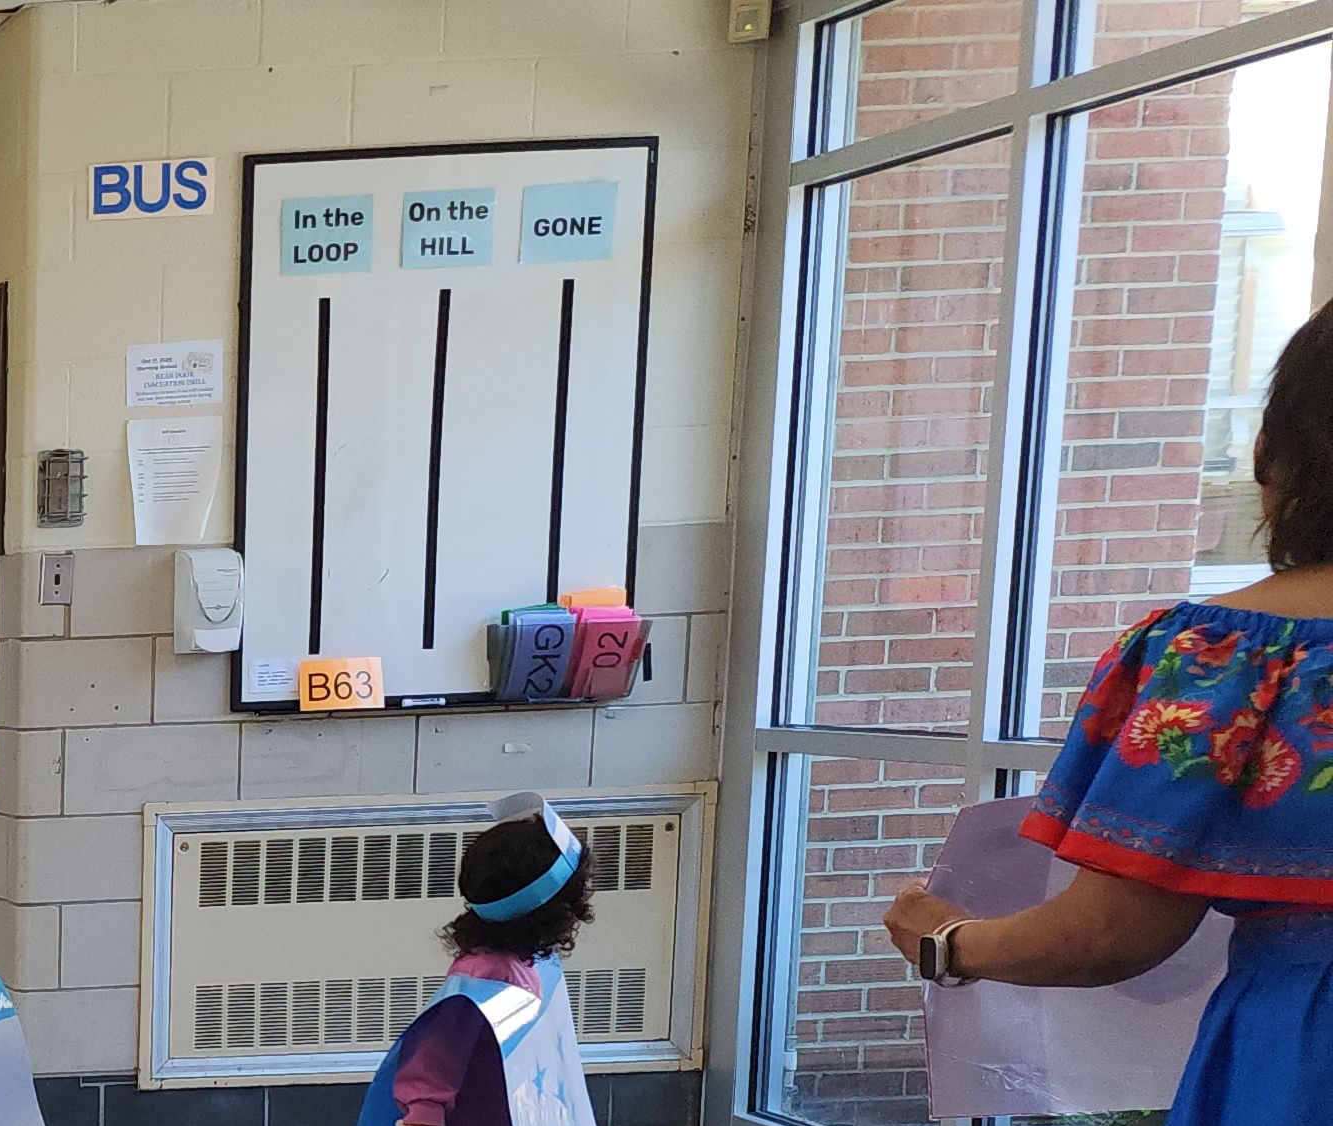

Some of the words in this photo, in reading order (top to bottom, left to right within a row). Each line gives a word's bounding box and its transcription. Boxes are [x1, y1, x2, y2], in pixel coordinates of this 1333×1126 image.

[92, 160, 208, 216] BUS
[293, 209, 318, 230] In
[322, 208, 365, 229] the
[408, 202, 443, 224] On
[447, 200, 489, 221] the
[533, 216, 603, 238] GONE
[292, 242, 359, 265] LOOP
[420, 235, 475, 258] HILL
[523, 623, 565, 695] GK2
[307, 670, 374, 703] B63
